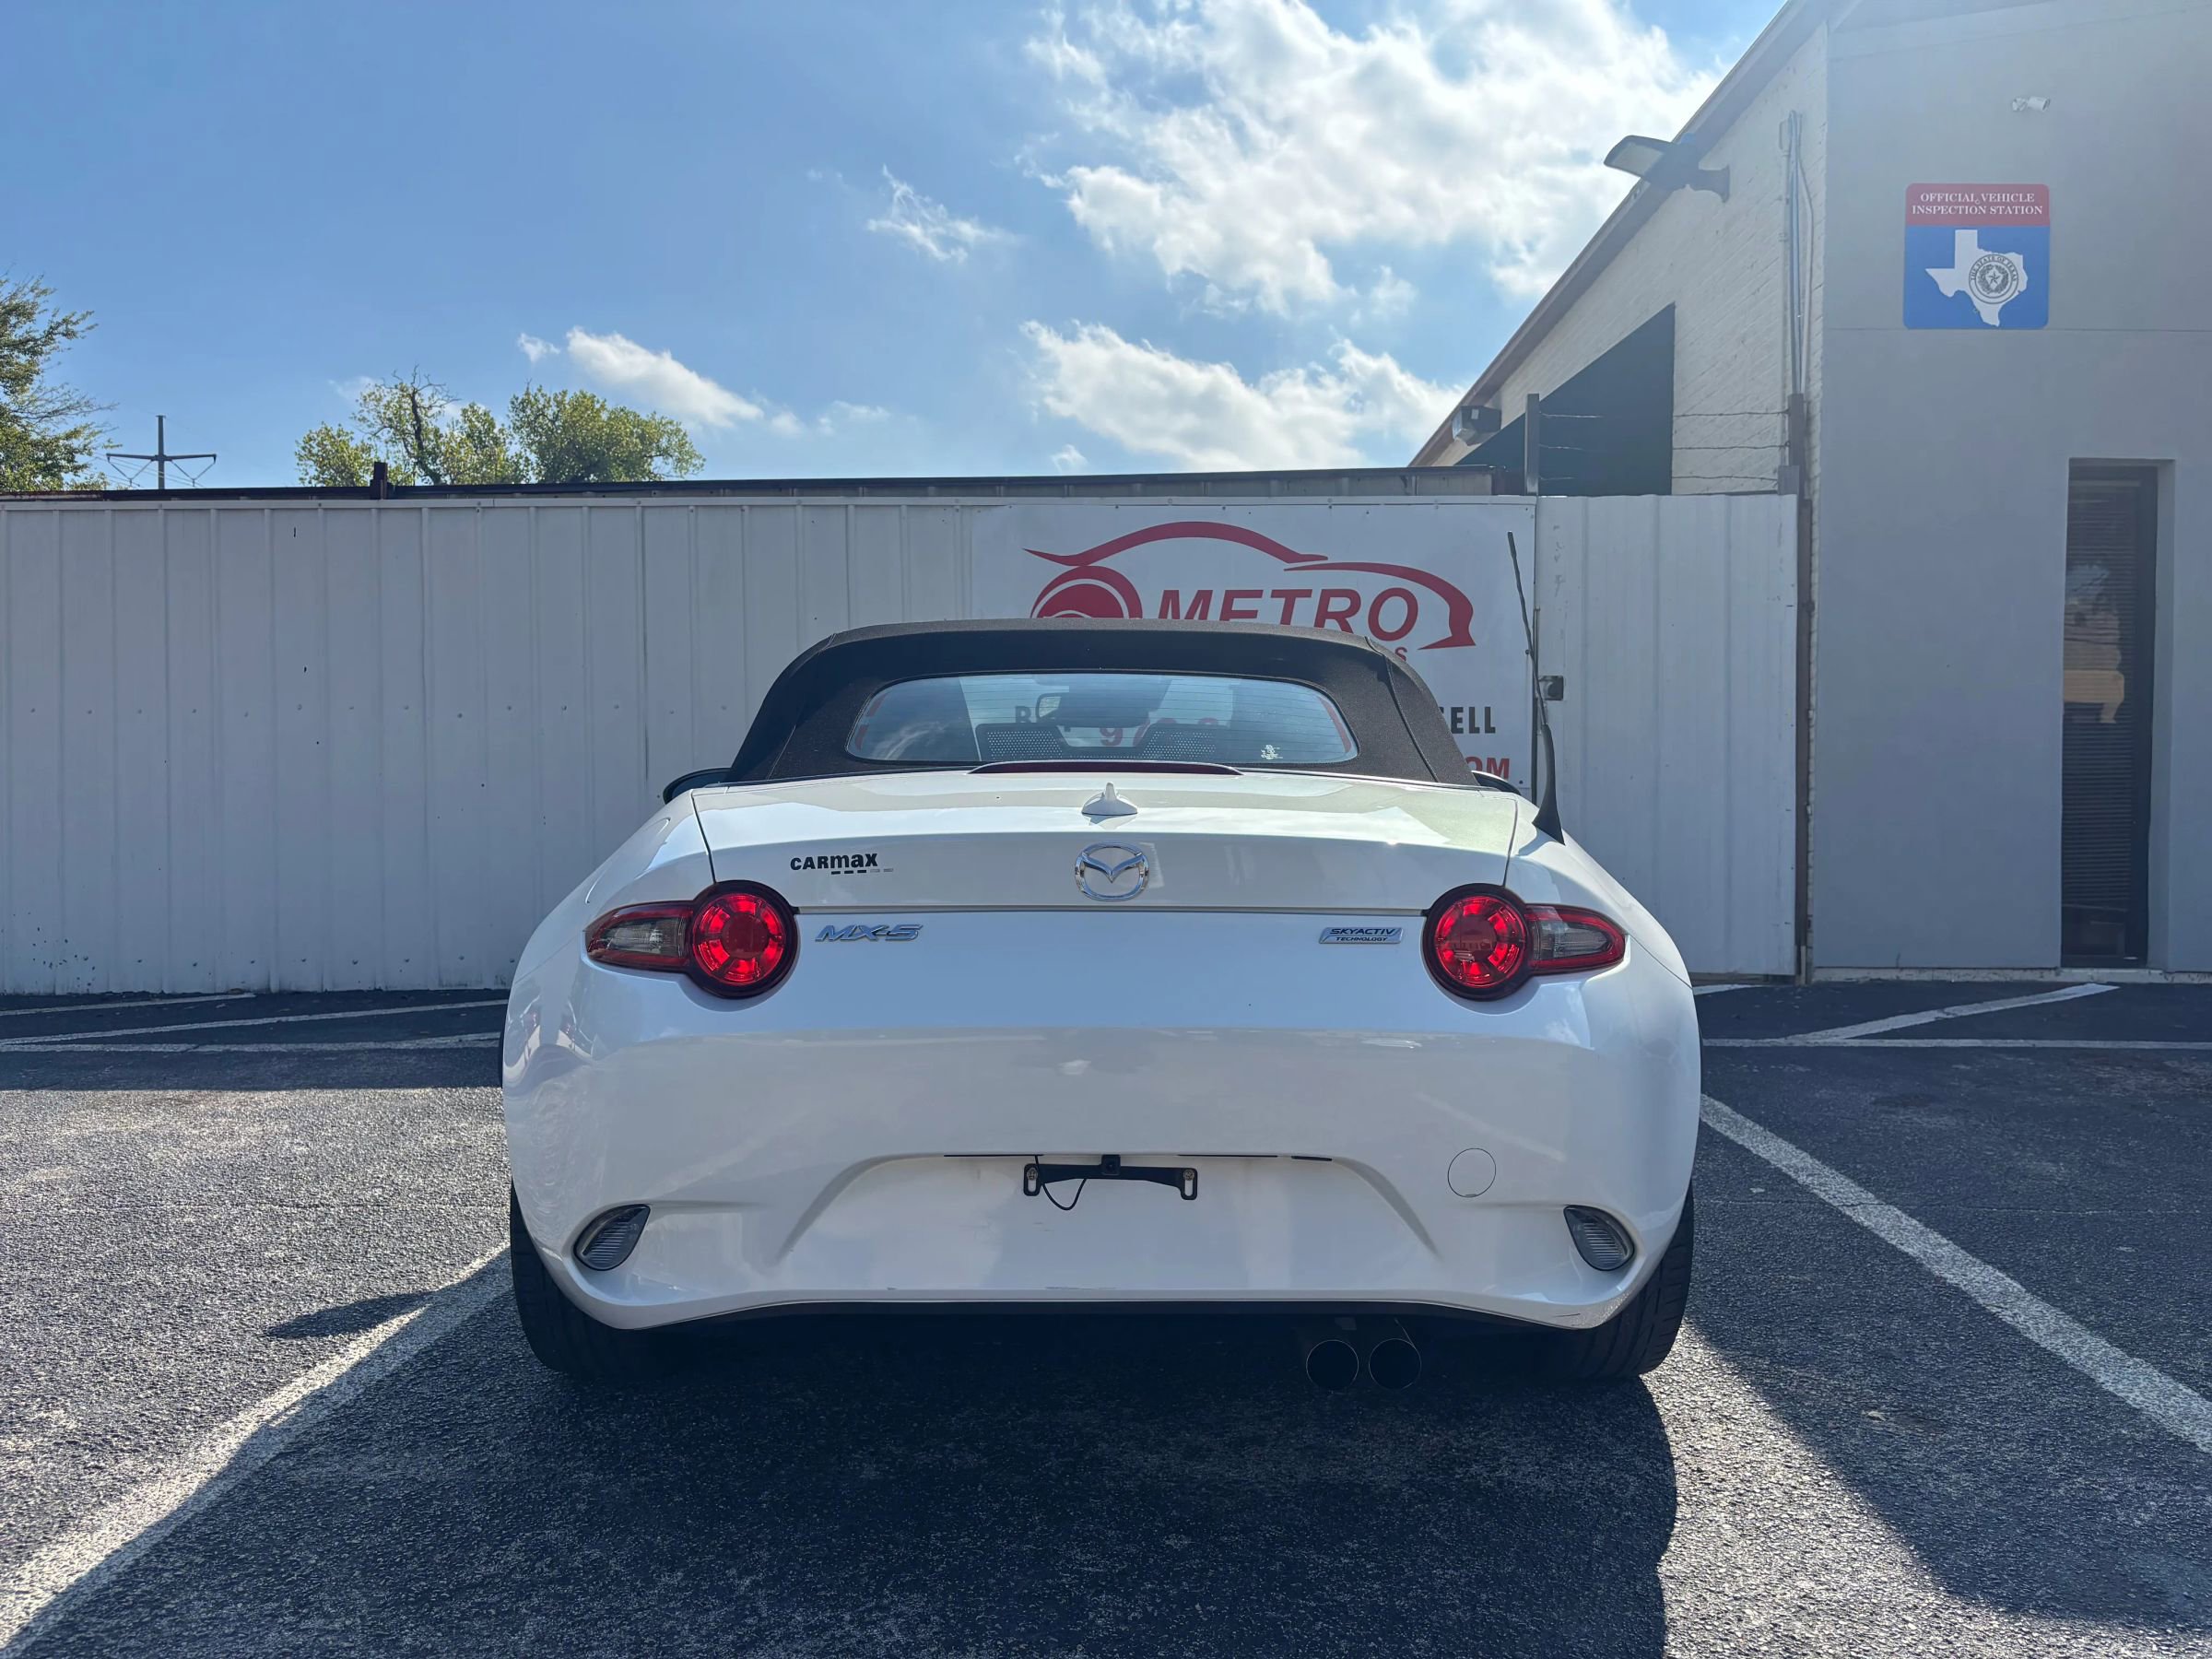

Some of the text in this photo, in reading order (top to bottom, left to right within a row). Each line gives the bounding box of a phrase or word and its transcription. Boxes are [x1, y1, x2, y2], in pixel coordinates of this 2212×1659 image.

[1920, 193, 2035, 203] OFFICIAL VEHICLE
[1912, 205, 2043, 215] INSPECTION STATION
[1158, 587, 1419, 641] METRO
[1439, 706, 1496, 734] ELL
[815, 924, 923, 942] MX-5
